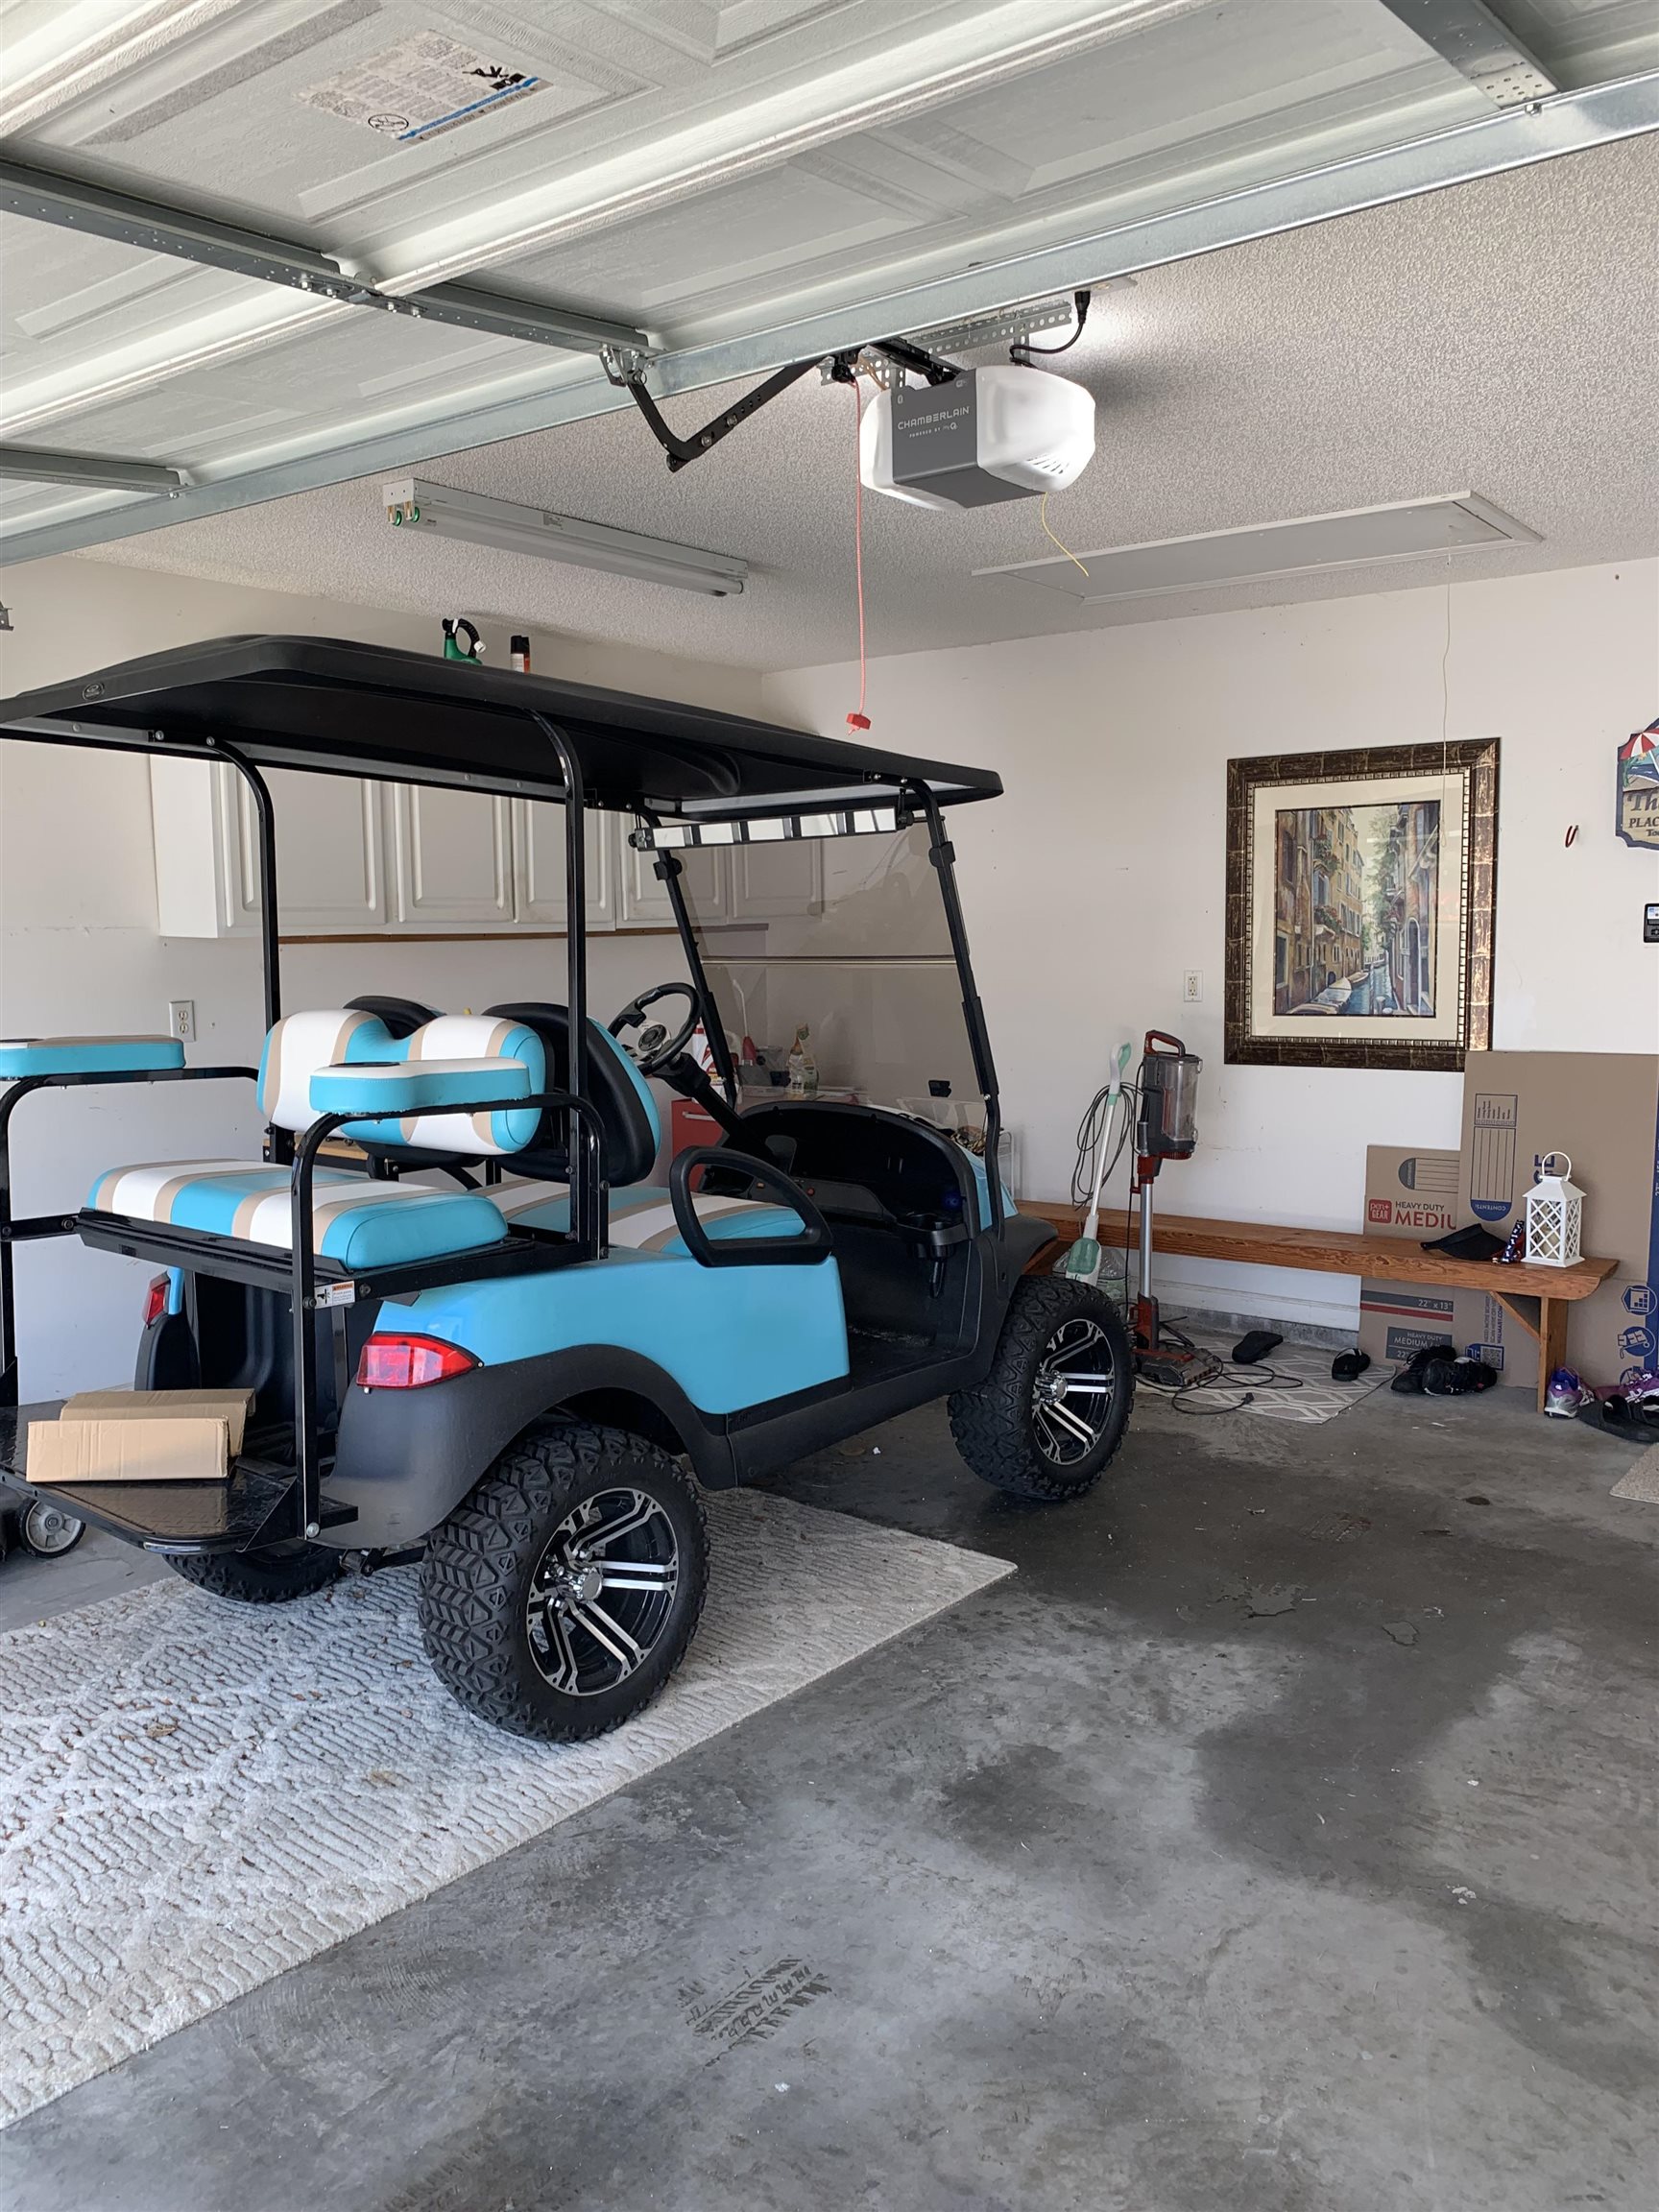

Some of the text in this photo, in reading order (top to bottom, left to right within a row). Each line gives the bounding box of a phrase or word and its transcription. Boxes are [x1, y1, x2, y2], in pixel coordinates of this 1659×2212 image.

[897, 405, 970, 430] CHAMBERLAIN
[1626, 789, 1659, 812] Th
[1646, 829, 1659, 837] To
[1395, 1201, 1445, 1212] HEAVY DUTY
[1371, 1209, 1388, 1220] GEAR
[1418, 1299, 1431, 1308] 22"
[1394, 1337, 1428, 1349] MEDIUM
